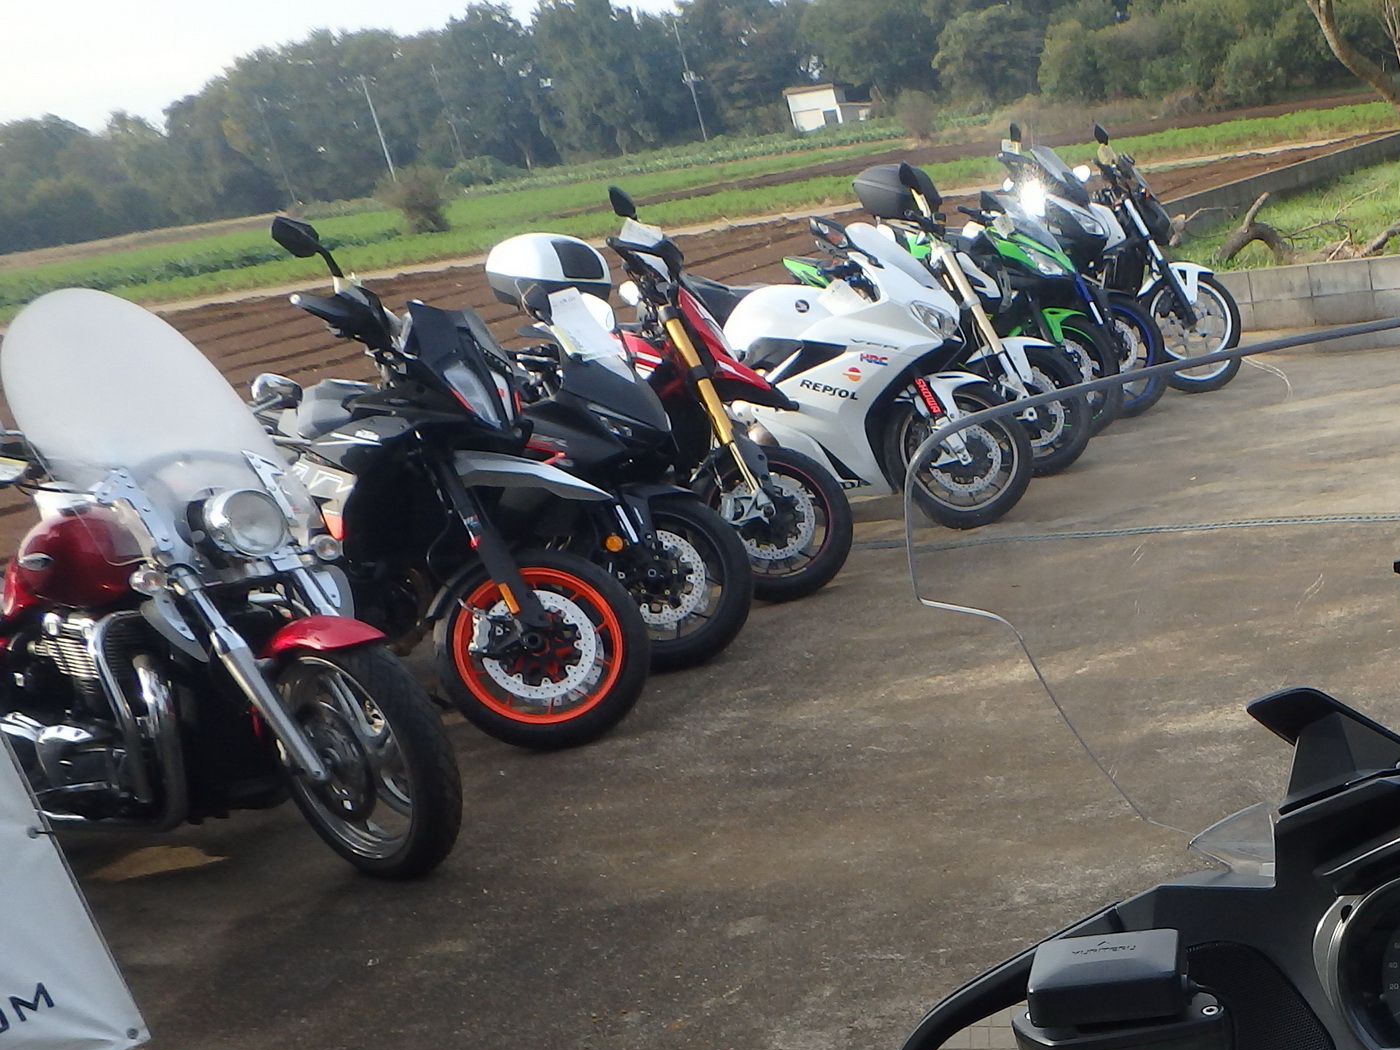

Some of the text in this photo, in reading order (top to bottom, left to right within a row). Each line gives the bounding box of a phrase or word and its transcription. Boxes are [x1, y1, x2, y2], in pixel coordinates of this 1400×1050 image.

[860, 353, 888, 366] HRC
[800, 379, 858, 400] REPSOL
[914, 378, 942, 414] SHOWA
